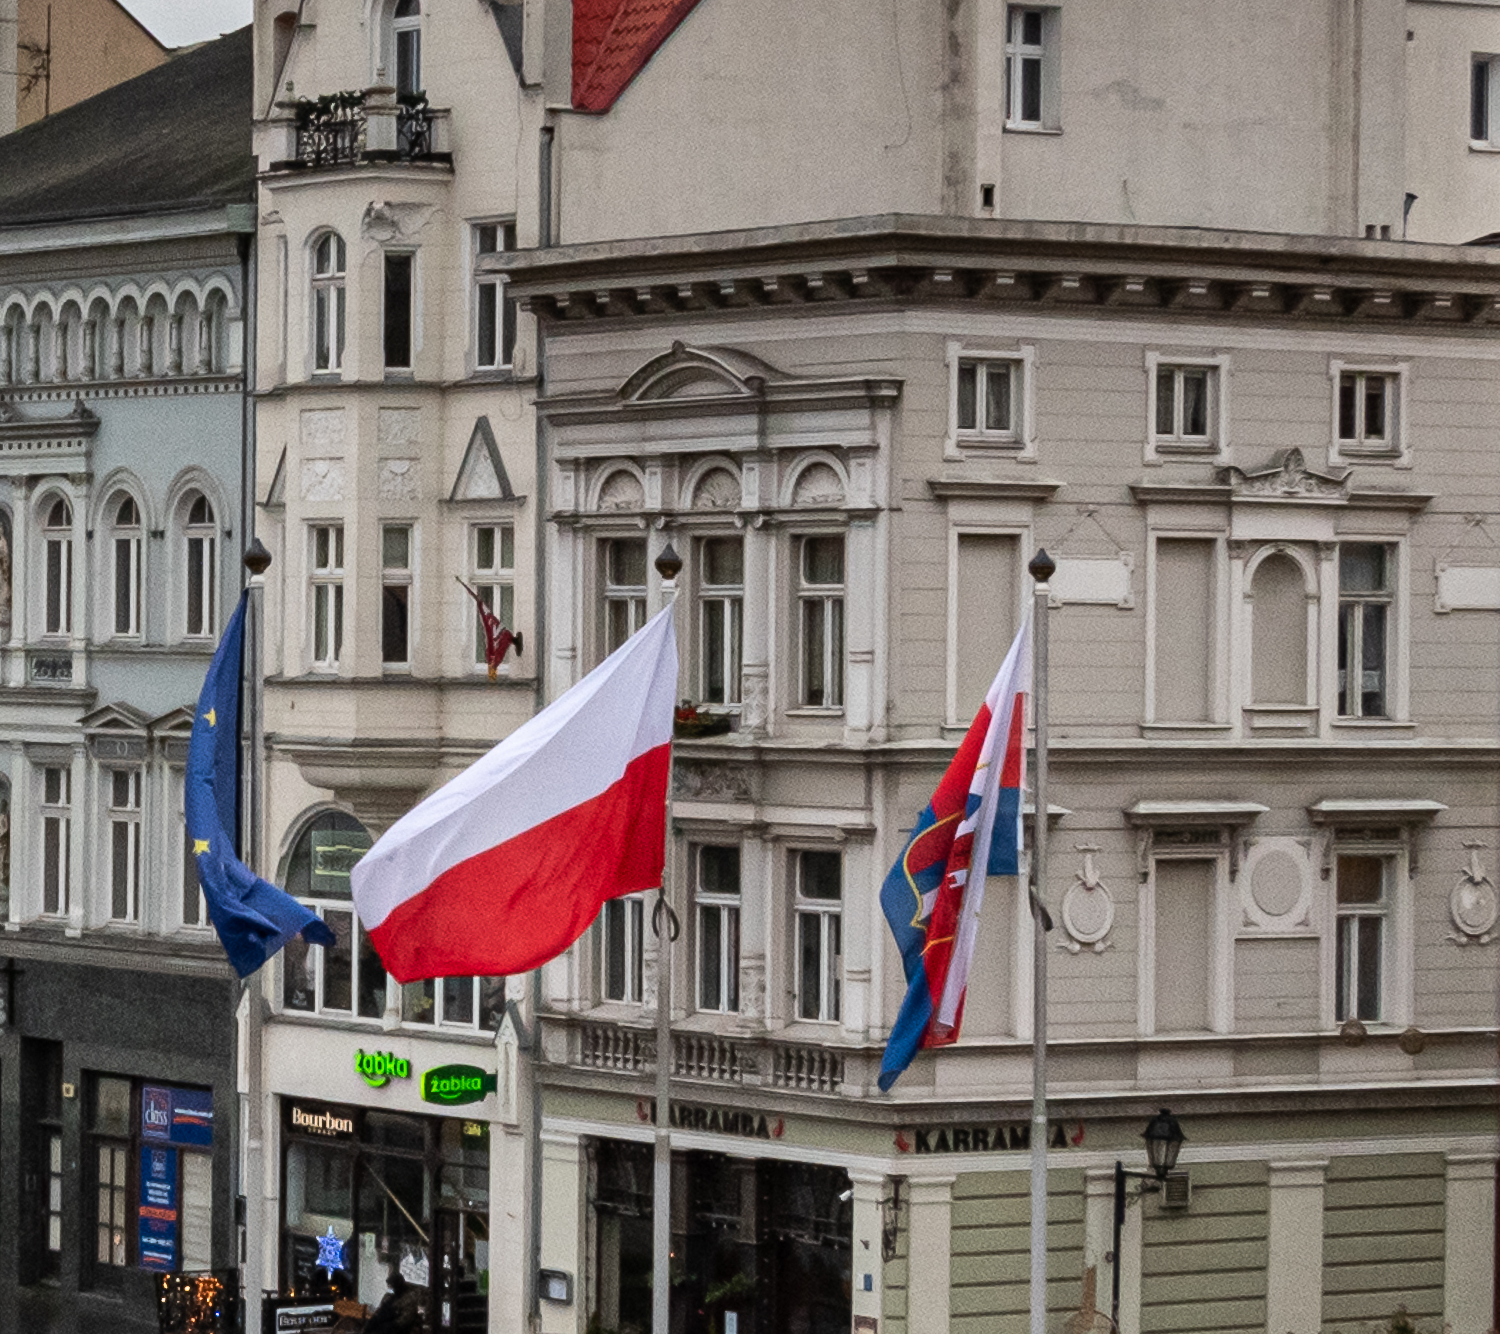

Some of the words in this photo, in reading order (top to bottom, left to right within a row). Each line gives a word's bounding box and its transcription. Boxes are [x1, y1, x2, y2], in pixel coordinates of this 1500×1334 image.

[430, 1075, 482, 1093] żabka
[292, 1107, 353, 1133] Bourbon
[915, 1124, 1068, 1154] KARRAMA
